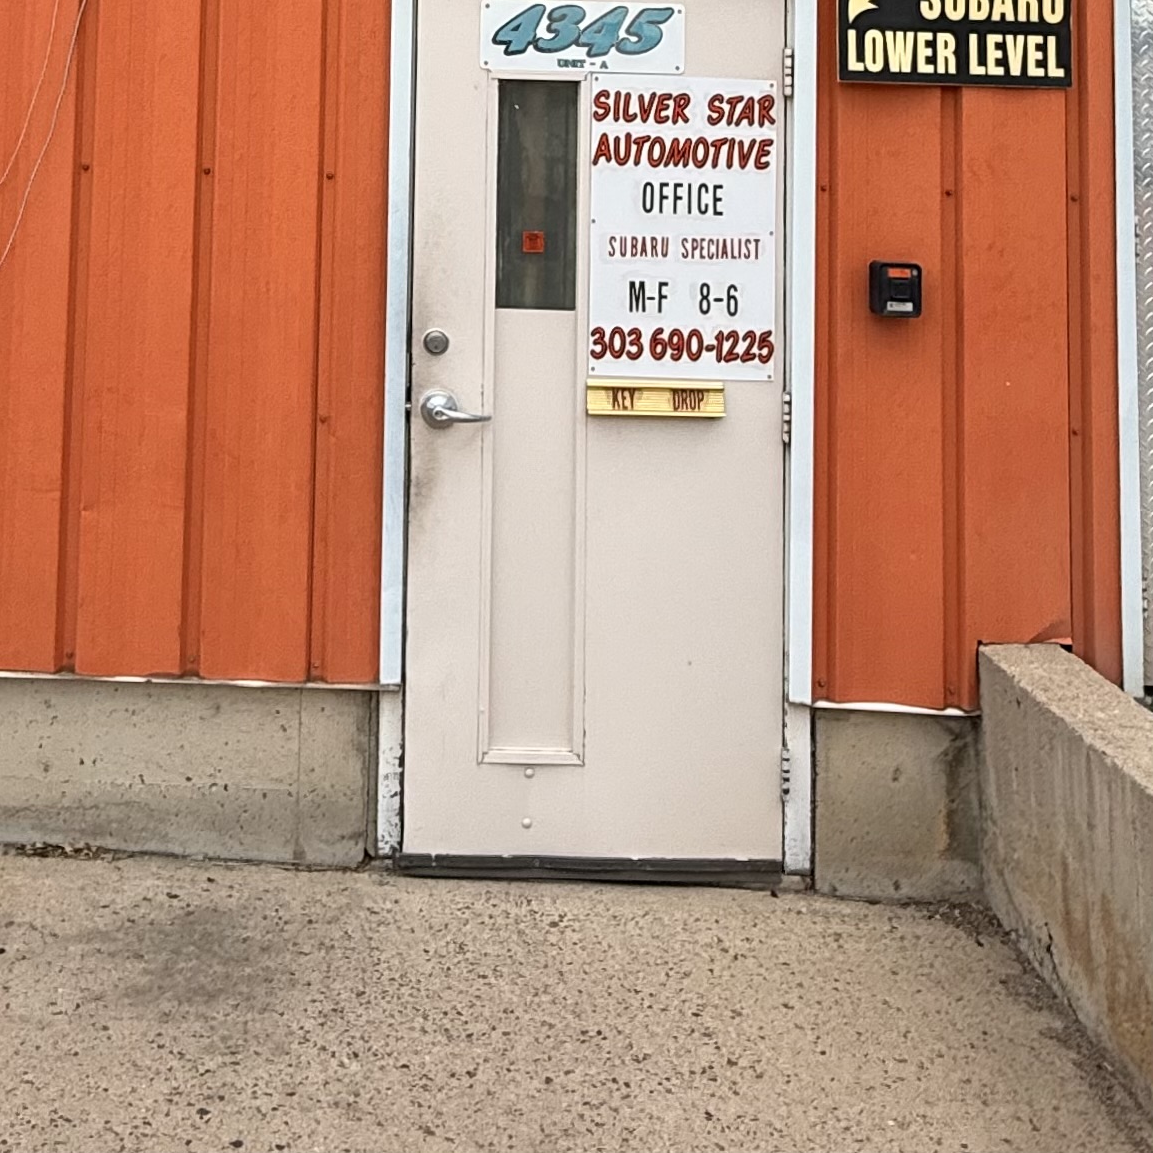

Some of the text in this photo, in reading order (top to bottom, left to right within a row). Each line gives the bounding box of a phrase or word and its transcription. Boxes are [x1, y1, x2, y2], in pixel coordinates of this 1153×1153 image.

[492, 3, 675, 58] 4345
[599, 60, 609, 70] A
[847, 28, 1065, 78] LOWER LEVEL
[593, 89, 777, 128] SILVER STAR
[592, 132, 774, 171] AUTOMOTIVE
[641, 181, 724, 216] OFFICE
[608, 235, 761, 261] SUBARU SPECIALIST
[628, 281, 739, 317] M-F 8-6
[590, 327, 775, 364] 303 690-1225
[612, 388, 704, 411] KEY DROP
